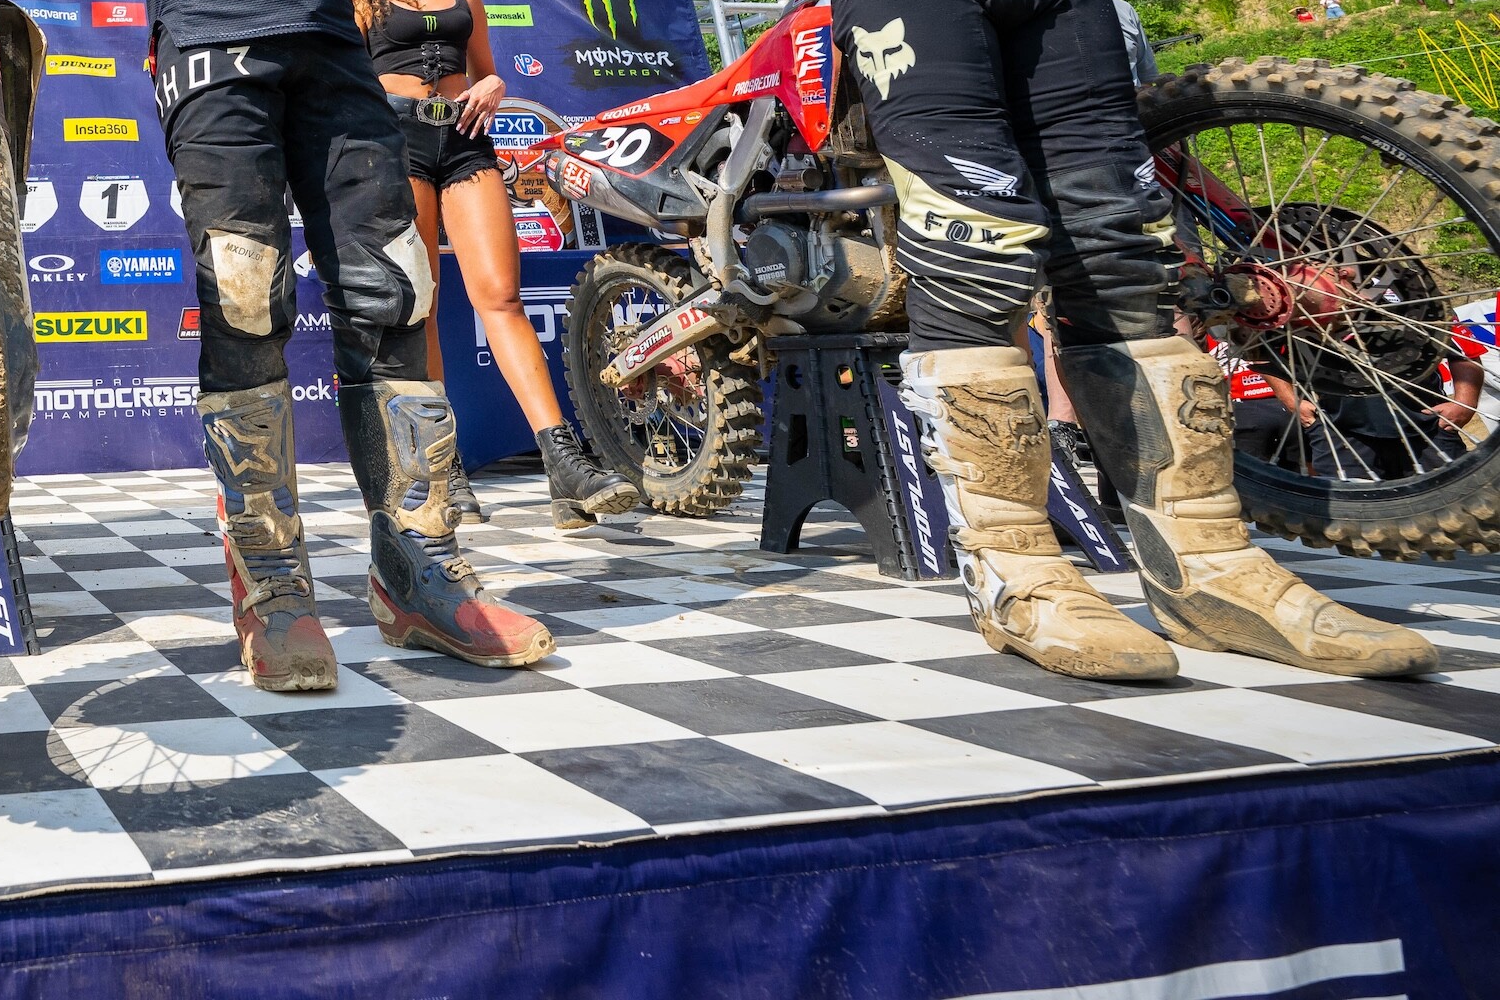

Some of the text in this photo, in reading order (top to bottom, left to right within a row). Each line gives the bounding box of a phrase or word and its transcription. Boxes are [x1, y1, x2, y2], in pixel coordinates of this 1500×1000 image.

[485, 11, 526, 22] Kawasaki
[575, 47, 674, 68] MONSTER
[59, 59, 113, 71] DUNLOP
[593, 68, 662, 77] ENERGY
[733, 69, 781, 97] PROGRESSIVE
[602, 102, 651, 121] HONDA
[560, 115, 596, 123] MOUNTAIN
[75, 123, 129, 136] Insta360
[495, 118, 535, 133] FXR
[491, 138, 518, 147] SPRING
[580, 127, 652, 168] 30
[520, 178, 535, 187] July
[524, 187, 544, 195] 2025
[519, 222, 539, 230] FXR
[122, 256, 176, 273] YAMAHA
[754, 263, 786, 275] HONDA
[35, 317, 143, 338] SUZUKI
[94, 378, 143, 388] PRO
[893, 411, 940, 574] UFOPLAST
